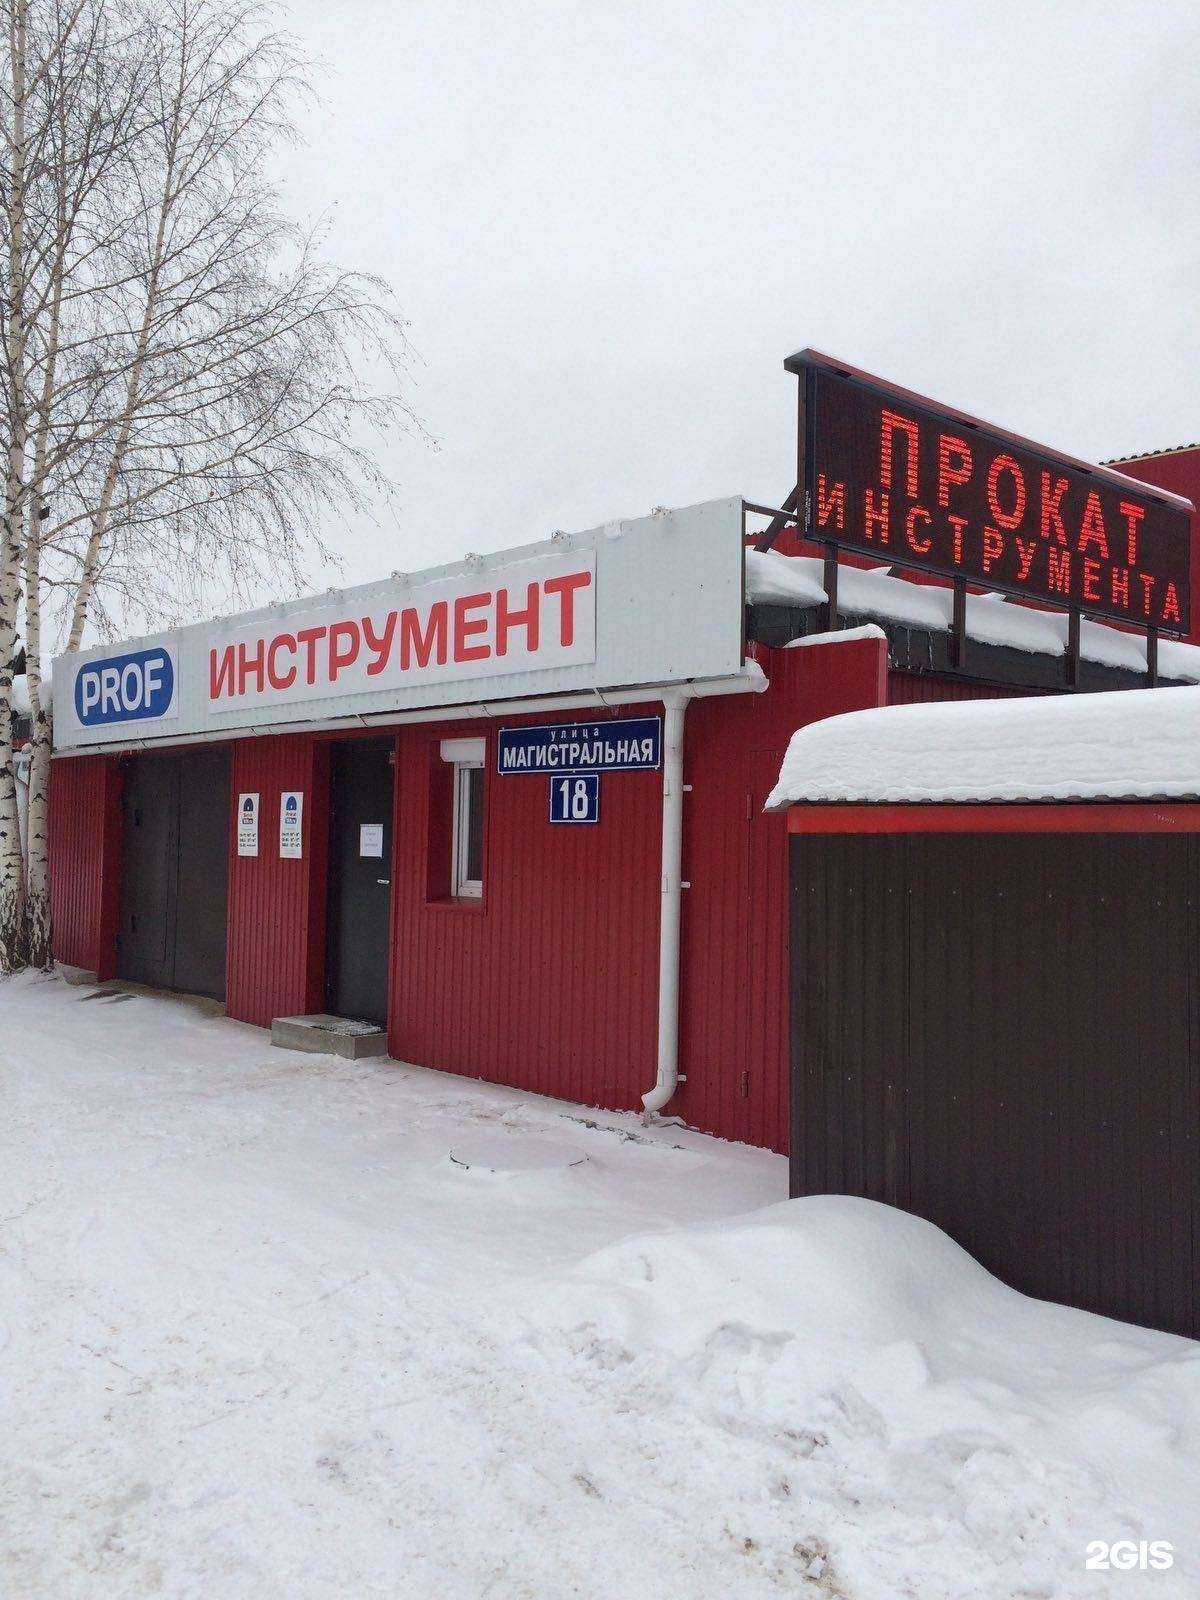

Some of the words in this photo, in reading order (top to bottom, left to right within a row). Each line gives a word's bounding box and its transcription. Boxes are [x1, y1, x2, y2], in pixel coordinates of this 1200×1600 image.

[881, 408, 1145, 565] ПРОКАТ
[817, 473, 1180, 622] ИНСТРУМЕНТА
[209, 571, 592, 699] ИНСТРУМЕНТ
[81, 659, 164, 716] PROF
[503, 739, 653, 768] МАГИСТРАЛЬНАЯ
[550, 727, 600, 742] улица
[559, 779, 589, 819] 18
